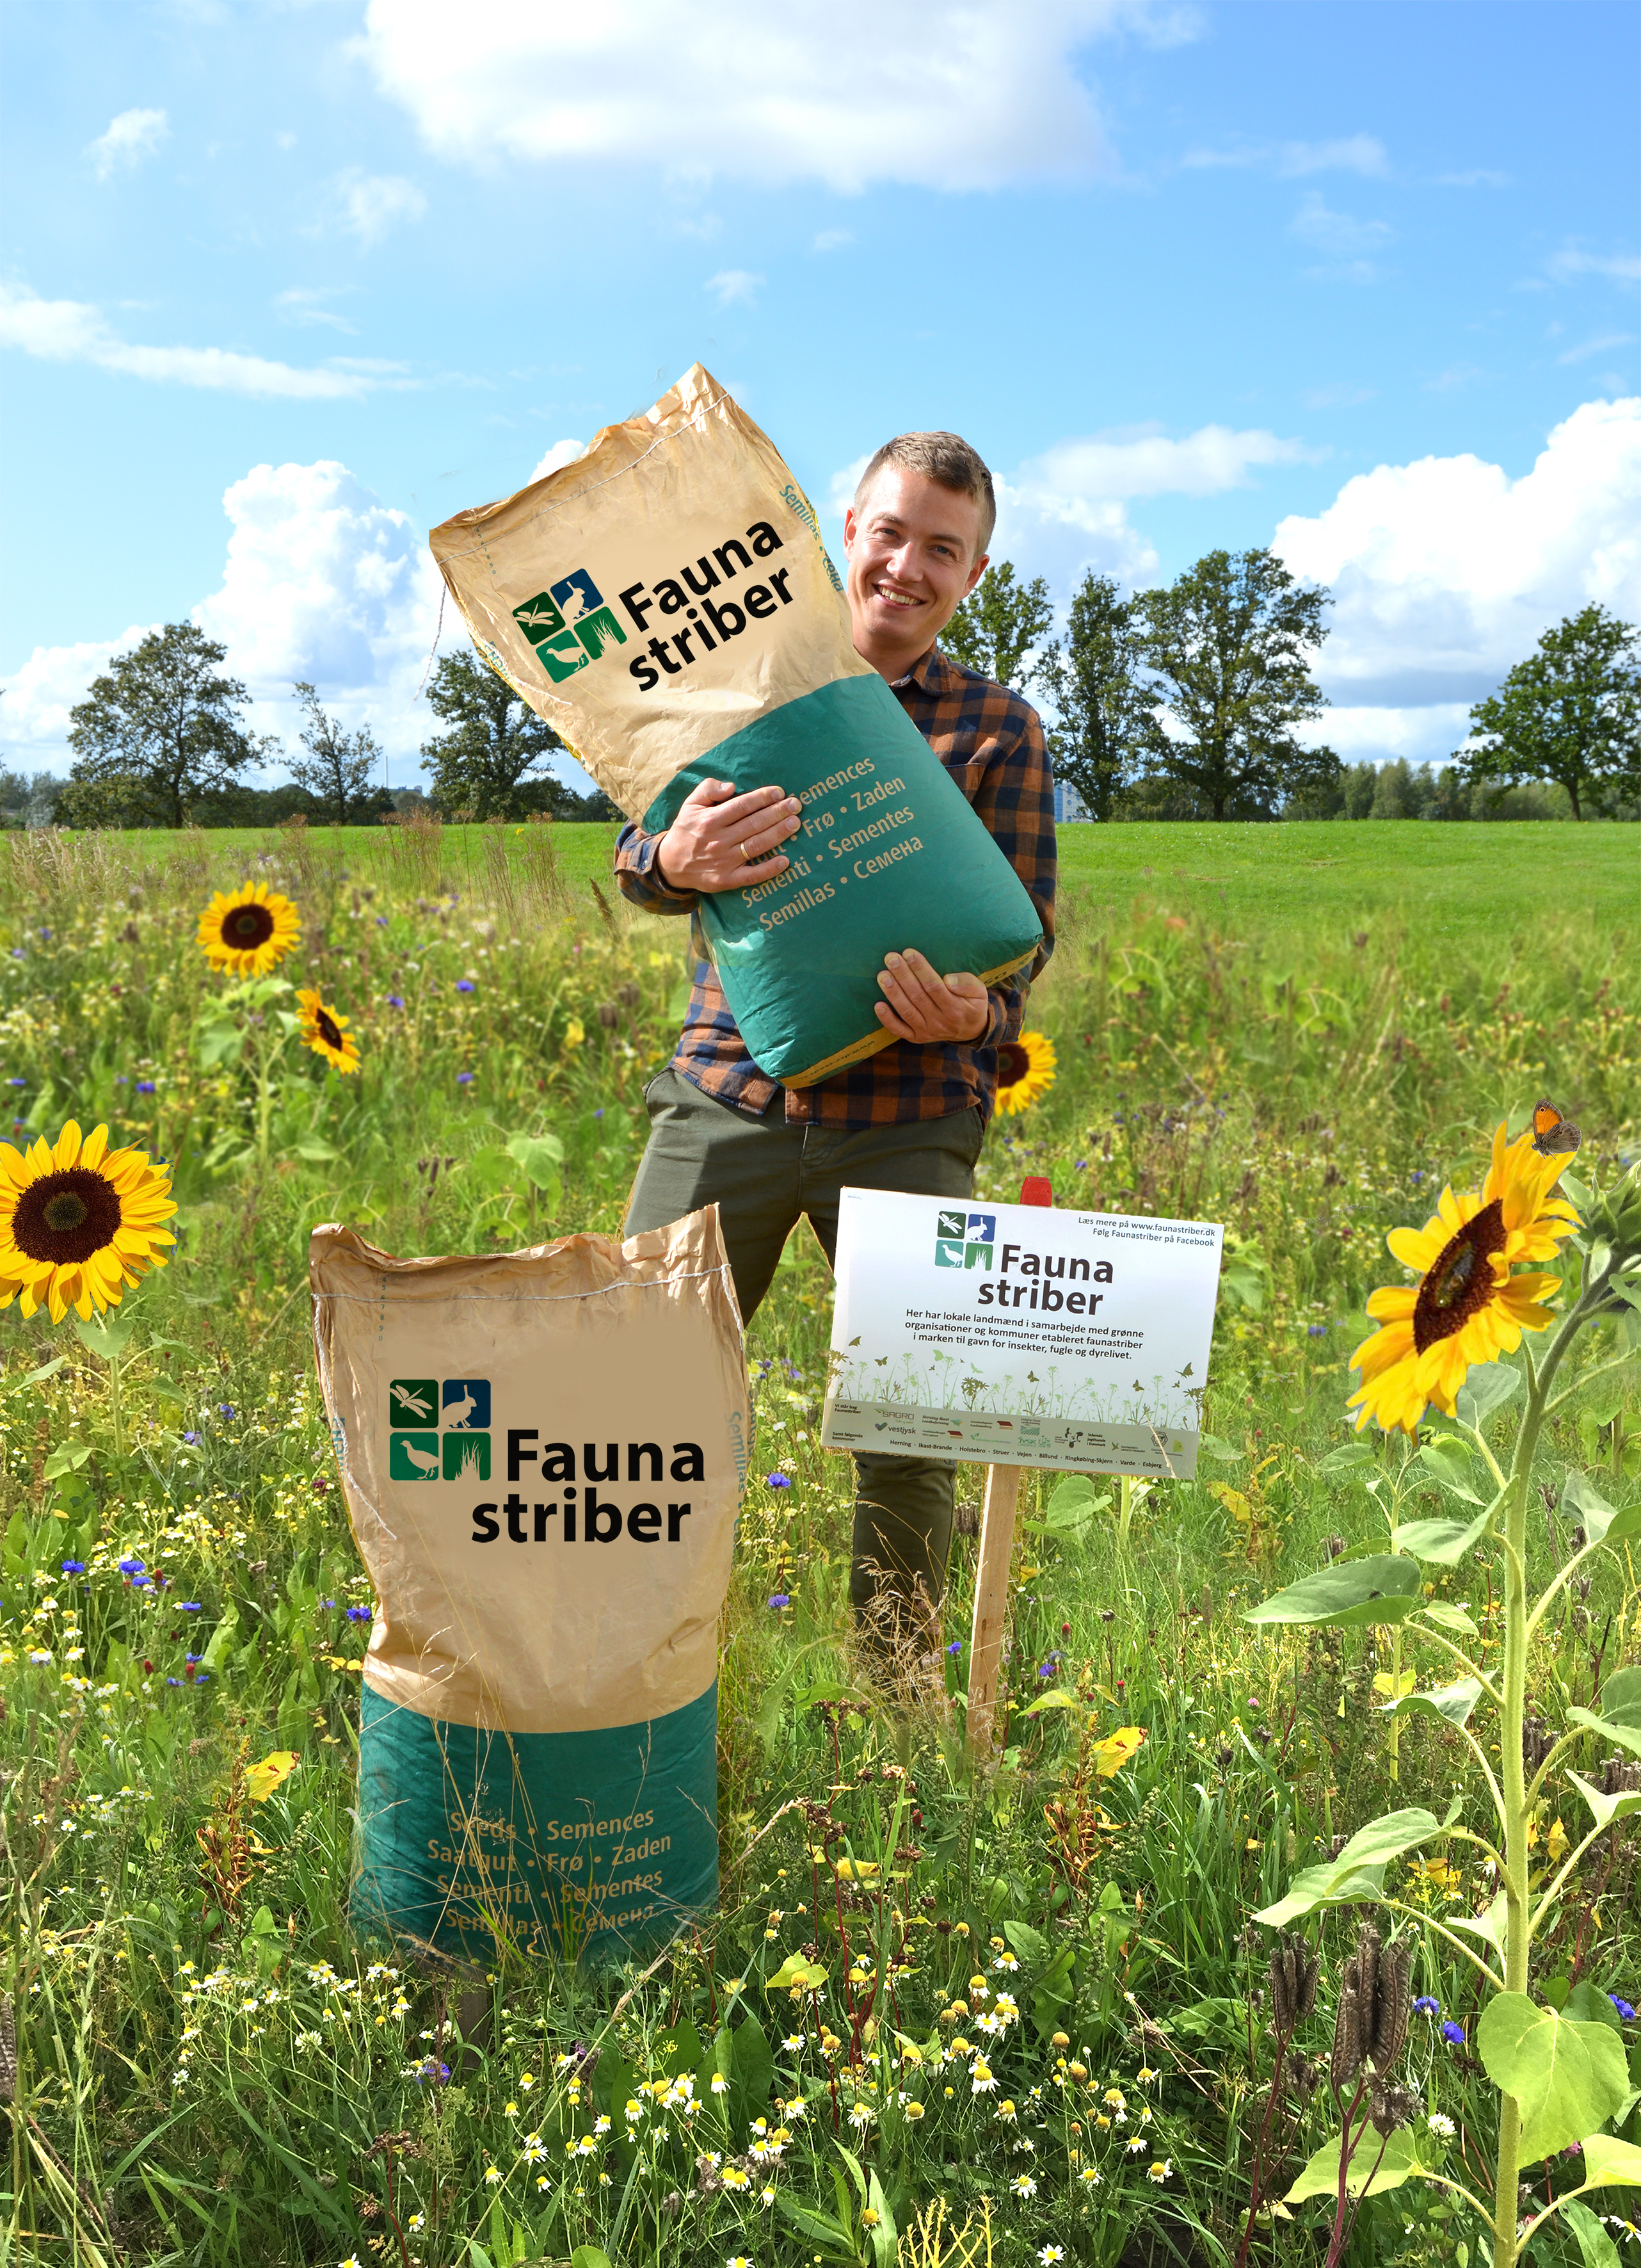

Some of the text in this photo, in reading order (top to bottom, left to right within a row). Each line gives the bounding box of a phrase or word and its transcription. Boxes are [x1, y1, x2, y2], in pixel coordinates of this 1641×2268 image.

[620, 521, 784, 633] Fauna
[628, 568, 793, 692] striber
[788, 757, 875, 805] emences
[802, 776, 906, 838] Frø Zaden
[741, 856, 812, 908] Sementi
[828, 805, 915, 858] Sementes
[759, 881, 835, 931] Semillas
[1093, 1228, 1215, 1247] Følg Faunastriber på Facebook
[1119, 1220, 1129, 1229] på
[1131, 1223, 1215, 1237] www.faunastriber.dk
[1000, 1244, 1114, 1283] Fauna
[977, 1278, 1103, 1316] striber
[905, 1321, 972, 1333] organisationer
[988, 1327, 1039, 1340] kommuner
[1041, 1334, 1084, 1344] etableret
[1087, 1337, 1143, 1349] faunastriber
[906, 1309, 923, 1317] Her
[925, 1310, 941, 1319] har
[943, 1312, 971, 1322] lokale
[973, 1314, 1023, 1326] landmænd
[1031, 1323, 1086, 1334] samarbejde
[1111, 1329, 1144, 1338] grønne
[913, 1332, 1132, 1360] i marken til gavn for insekter, fugle og dyrelivet.
[882, 1411, 914, 1420] SAGRO
[888, 1426, 917, 1435] vestjysk
[508, 1429, 705, 1483] Fauna
[1065, 1456, 1113, 1465] Ringkøbing-Skjern
[471, 1487, 691, 1543] striber
[451, 1810, 654, 1840] Seeds Semences
[428, 1835, 671, 1874] Saatgut Frø Zaden
[437, 1870, 662, 1904] Sementi Sementes
